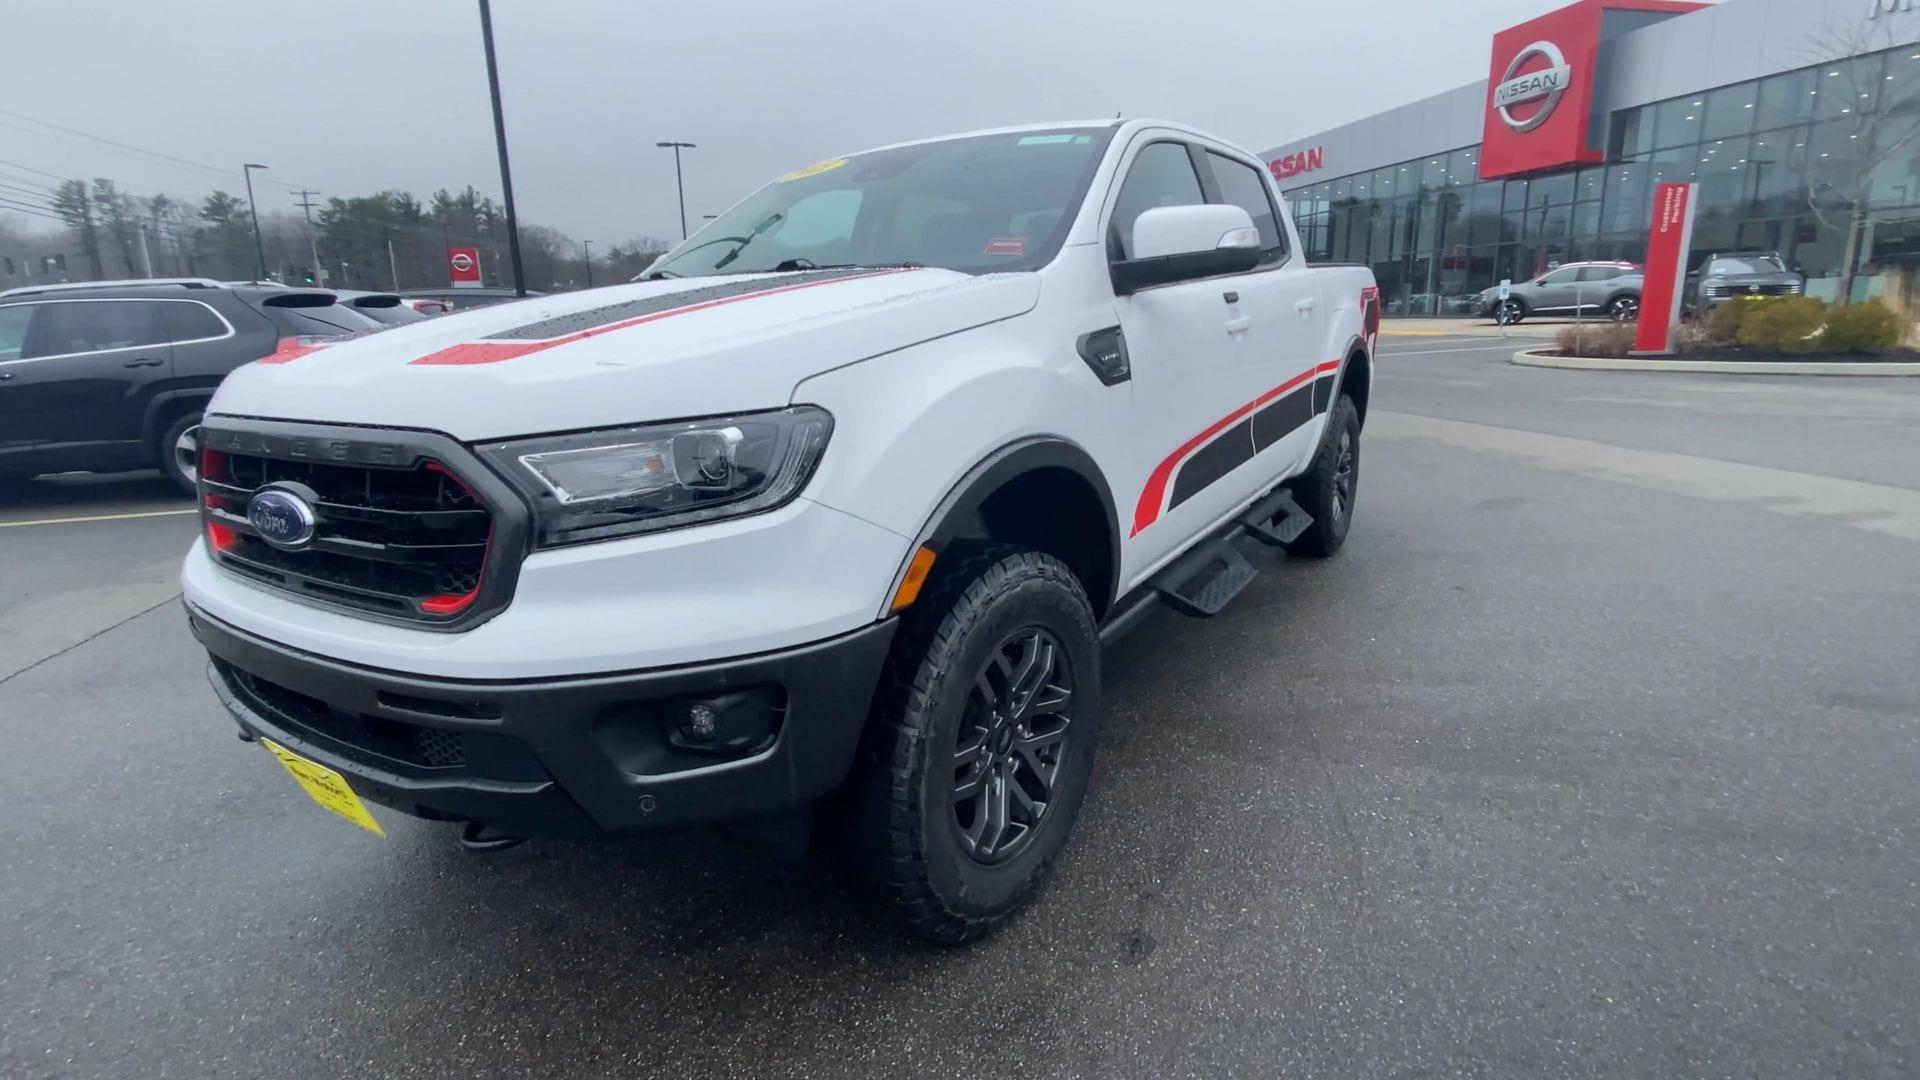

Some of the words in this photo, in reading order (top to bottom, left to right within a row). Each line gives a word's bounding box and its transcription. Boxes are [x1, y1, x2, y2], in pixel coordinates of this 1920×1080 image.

[1499, 73, 1558, 99] NISSAN
[1267, 146, 1324, 180] SSAN
[1660, 187, 1672, 232] Customer
[1671, 187, 1684, 223] Parking
